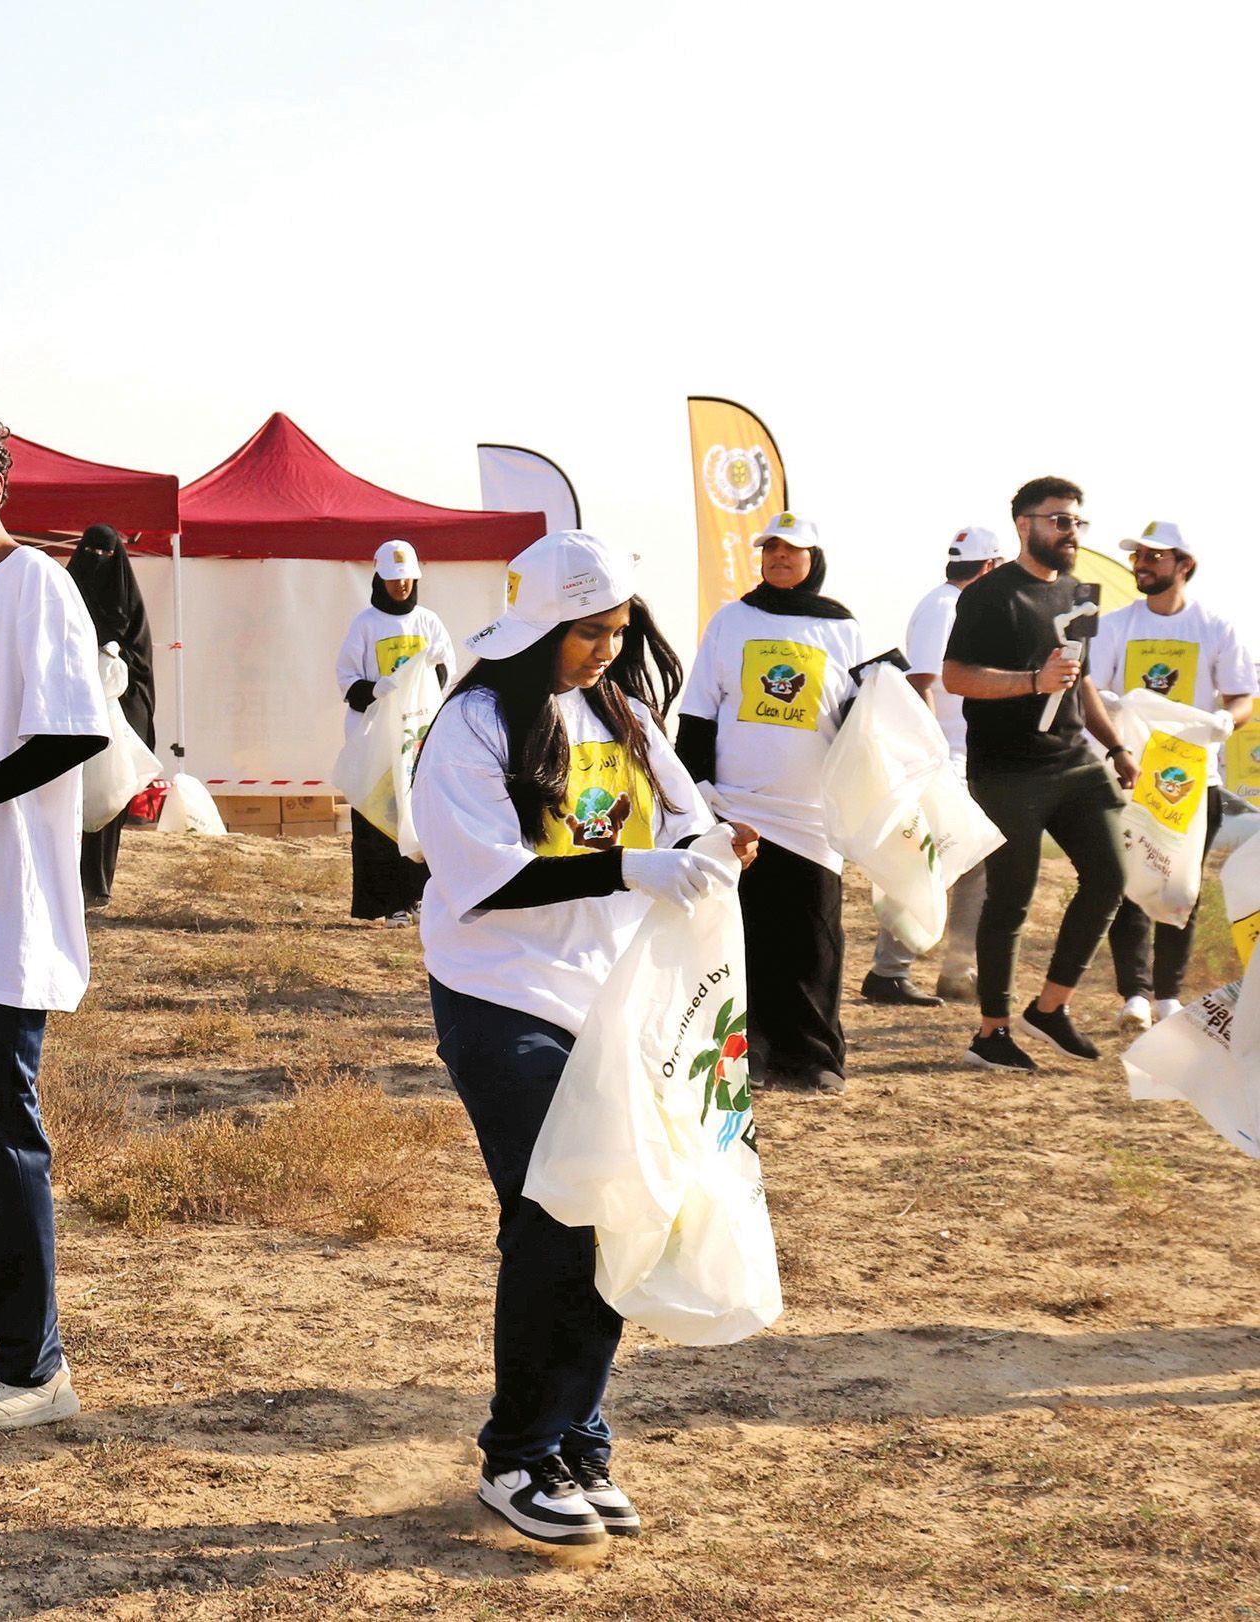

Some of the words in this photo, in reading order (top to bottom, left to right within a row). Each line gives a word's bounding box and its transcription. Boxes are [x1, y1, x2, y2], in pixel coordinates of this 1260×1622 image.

[755, 701, 779, 717] Clean
[783, 707, 807, 723] UAE
[706, 963, 731, 985] by
